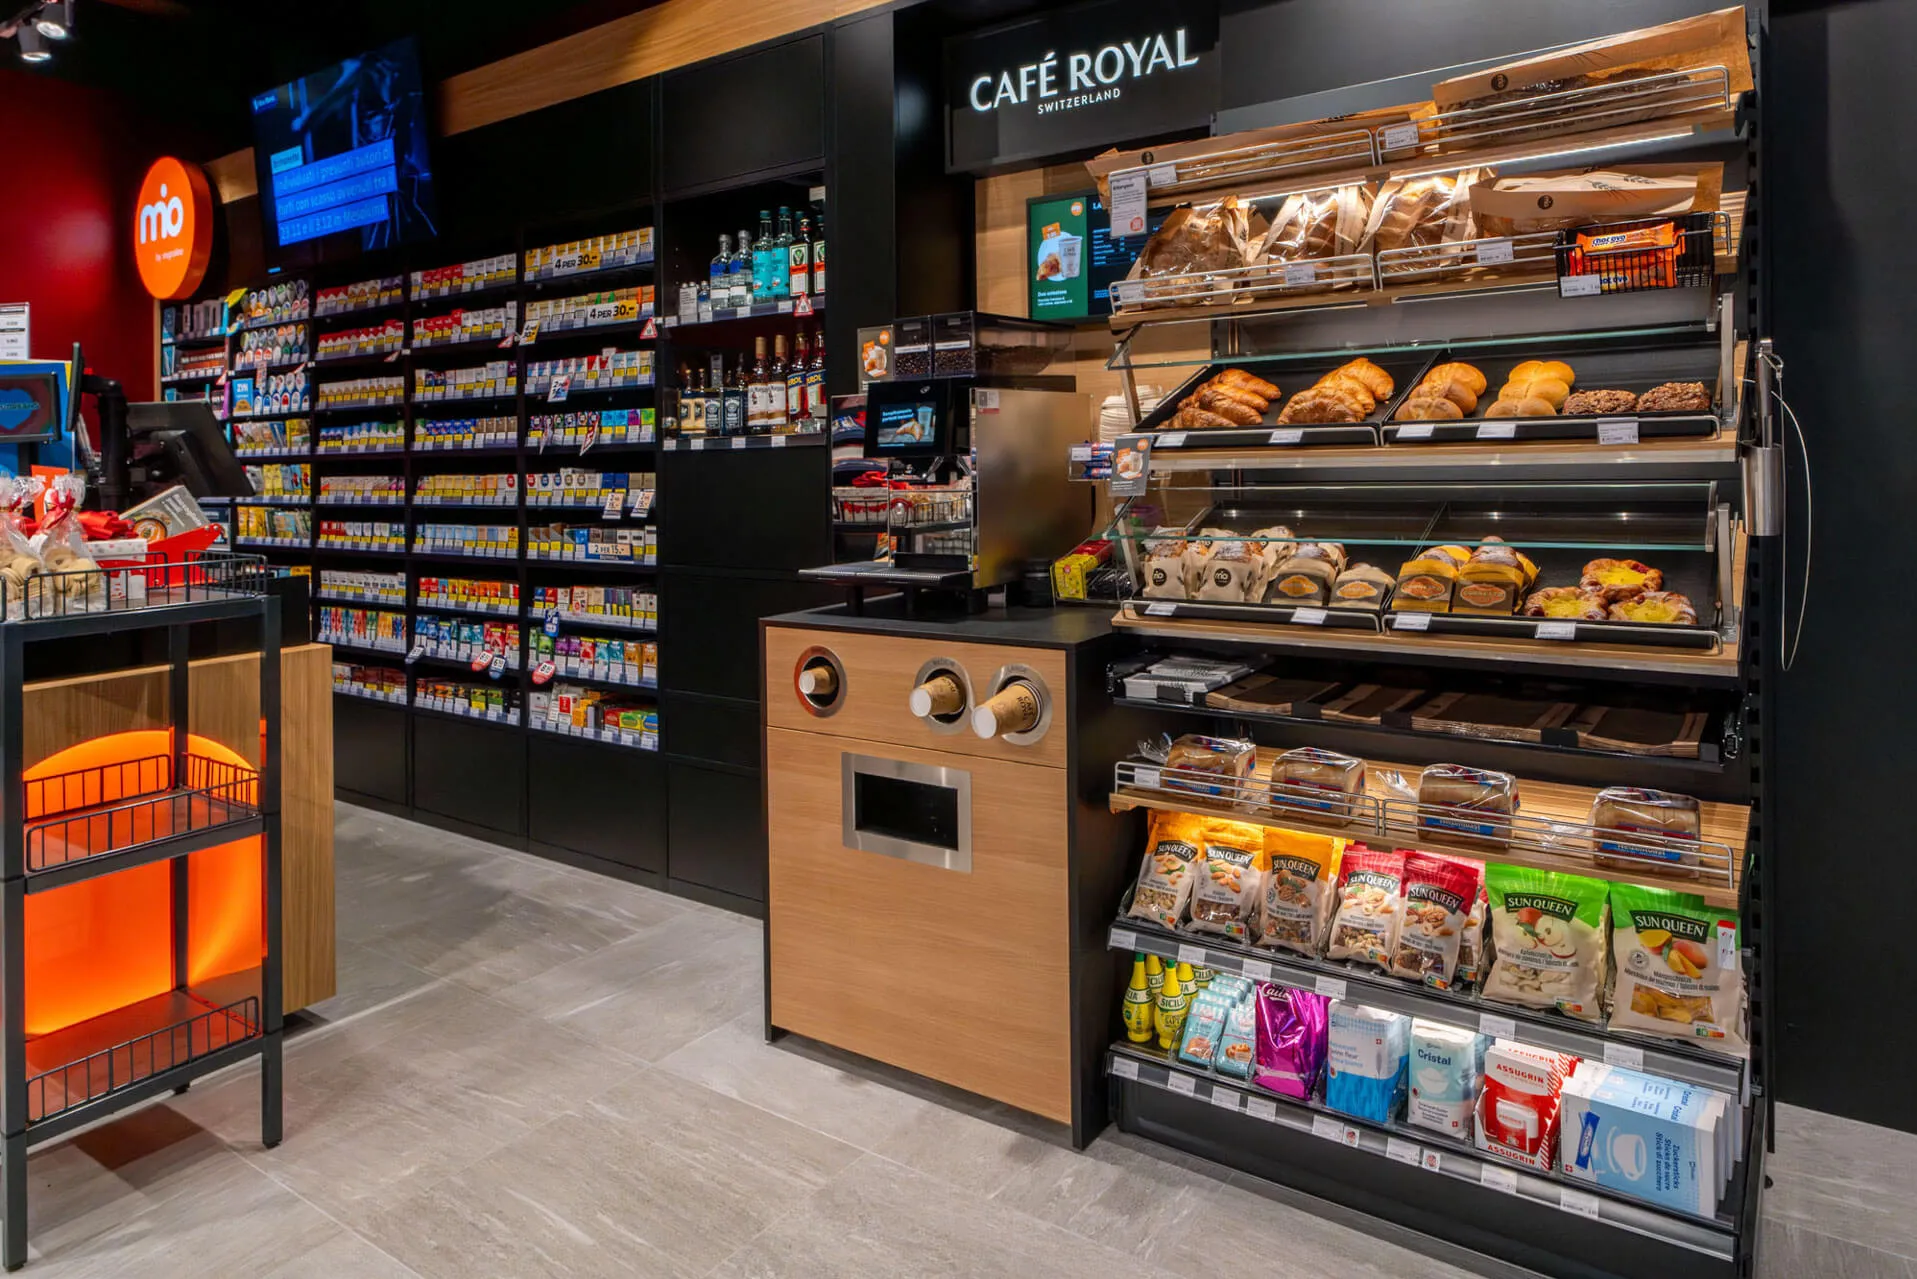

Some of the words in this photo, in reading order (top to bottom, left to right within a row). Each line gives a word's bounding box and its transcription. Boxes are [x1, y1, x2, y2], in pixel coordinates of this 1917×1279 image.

[970, 52, 1057, 112] CAFÉ
[1070, 29, 1199, 91] ROYAL
[1037, 88, 1121, 115] SWITZERLAND
[140, 183, 184, 244] mio
[554, 259, 561, 269] 4
[562, 260, 577, 269] PER
[589, 307, 597, 319] 4
[597, 309, 612, 318] PER
[1158, 843, 1172, 853] SUN
[1170, 845, 1193, 860] QUEEN
[1207, 850, 1224, 860] SUN
[1225, 851, 1252, 865] QUEEN
[1350, 875, 1366, 885] SUN
[1366, 875, 1396, 890] QUEEN
[1410, 886, 1428, 898] SUN
[1428, 890, 1460, 908] QUEEN
[1508, 897, 1532, 909] SUN
[1532, 899, 1573, 916] QUEEN
[1634, 915, 1660, 929] SUN
[1661, 918, 1706, 937] QUEEN
[1417, 1048, 1452, 1066] Cristal
[1496, 1063, 1544, 1084] ASSUGRIN
[1487, 1144, 1535, 1166] ASSUGRIN
